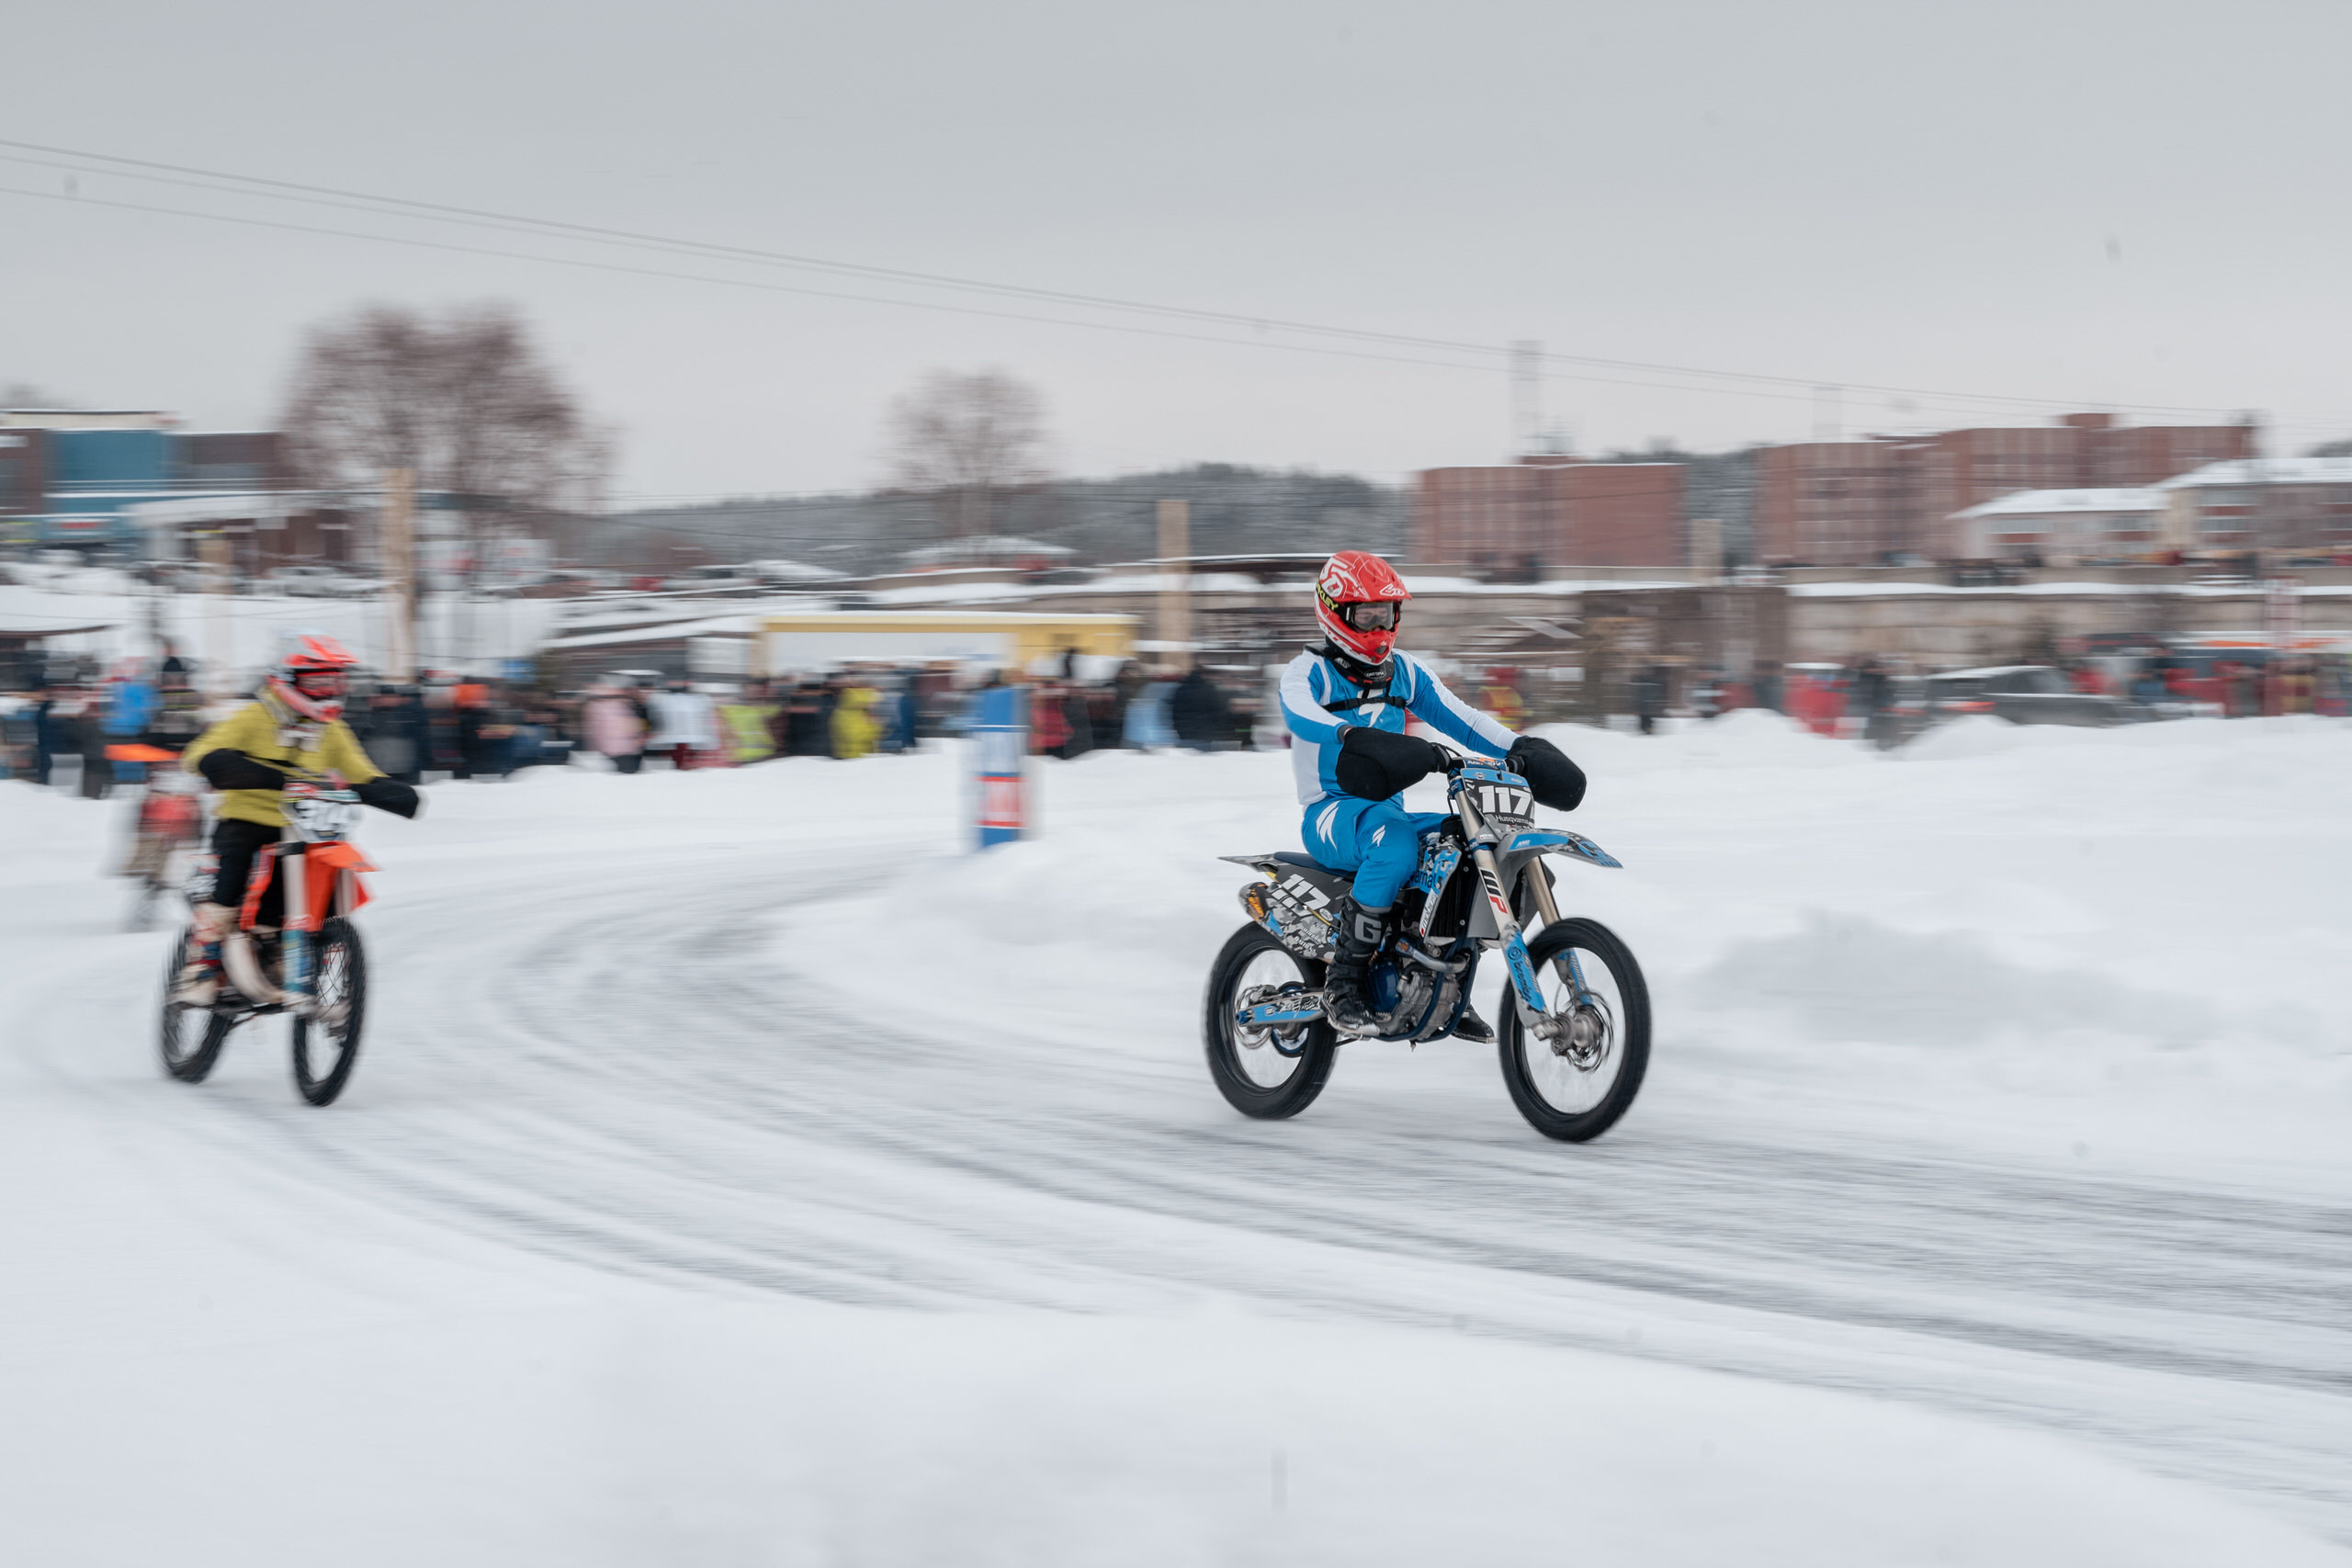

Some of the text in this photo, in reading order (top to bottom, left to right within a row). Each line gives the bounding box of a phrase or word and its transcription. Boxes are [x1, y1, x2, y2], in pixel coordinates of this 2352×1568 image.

[1316, 579, 1339, 611] AKLEY
[1478, 785, 1532, 816] 117
[1495, 815, 1530, 825] Husqvarna
[1272, 874, 1331, 917] 117
[1478, 867, 1508, 914] WP
[1355, 913, 1382, 944] G
